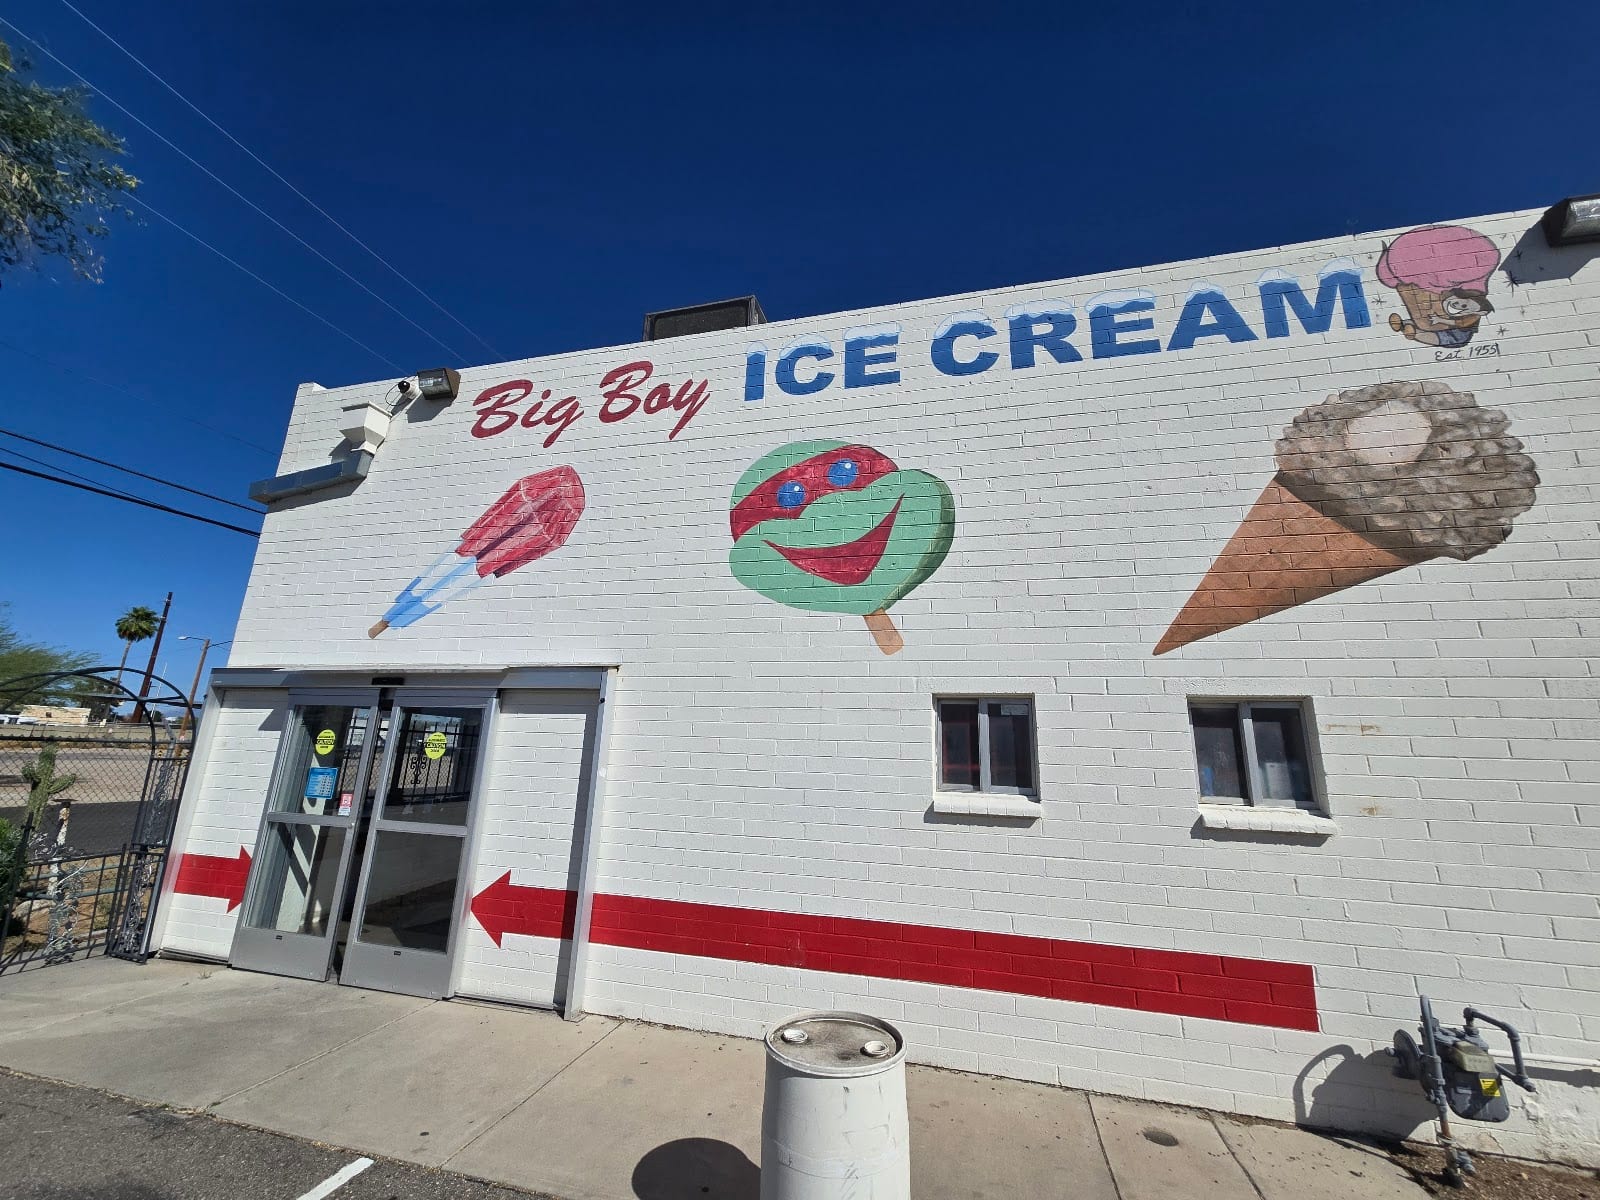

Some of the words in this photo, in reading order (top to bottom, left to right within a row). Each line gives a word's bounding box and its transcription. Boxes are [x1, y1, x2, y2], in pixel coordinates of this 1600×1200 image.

[470, 379, 585, 448] Big
[599, 360, 711, 440] Boy
[744, 325, 901, 401] ICE
[930, 264, 1372, 377] CREAM
